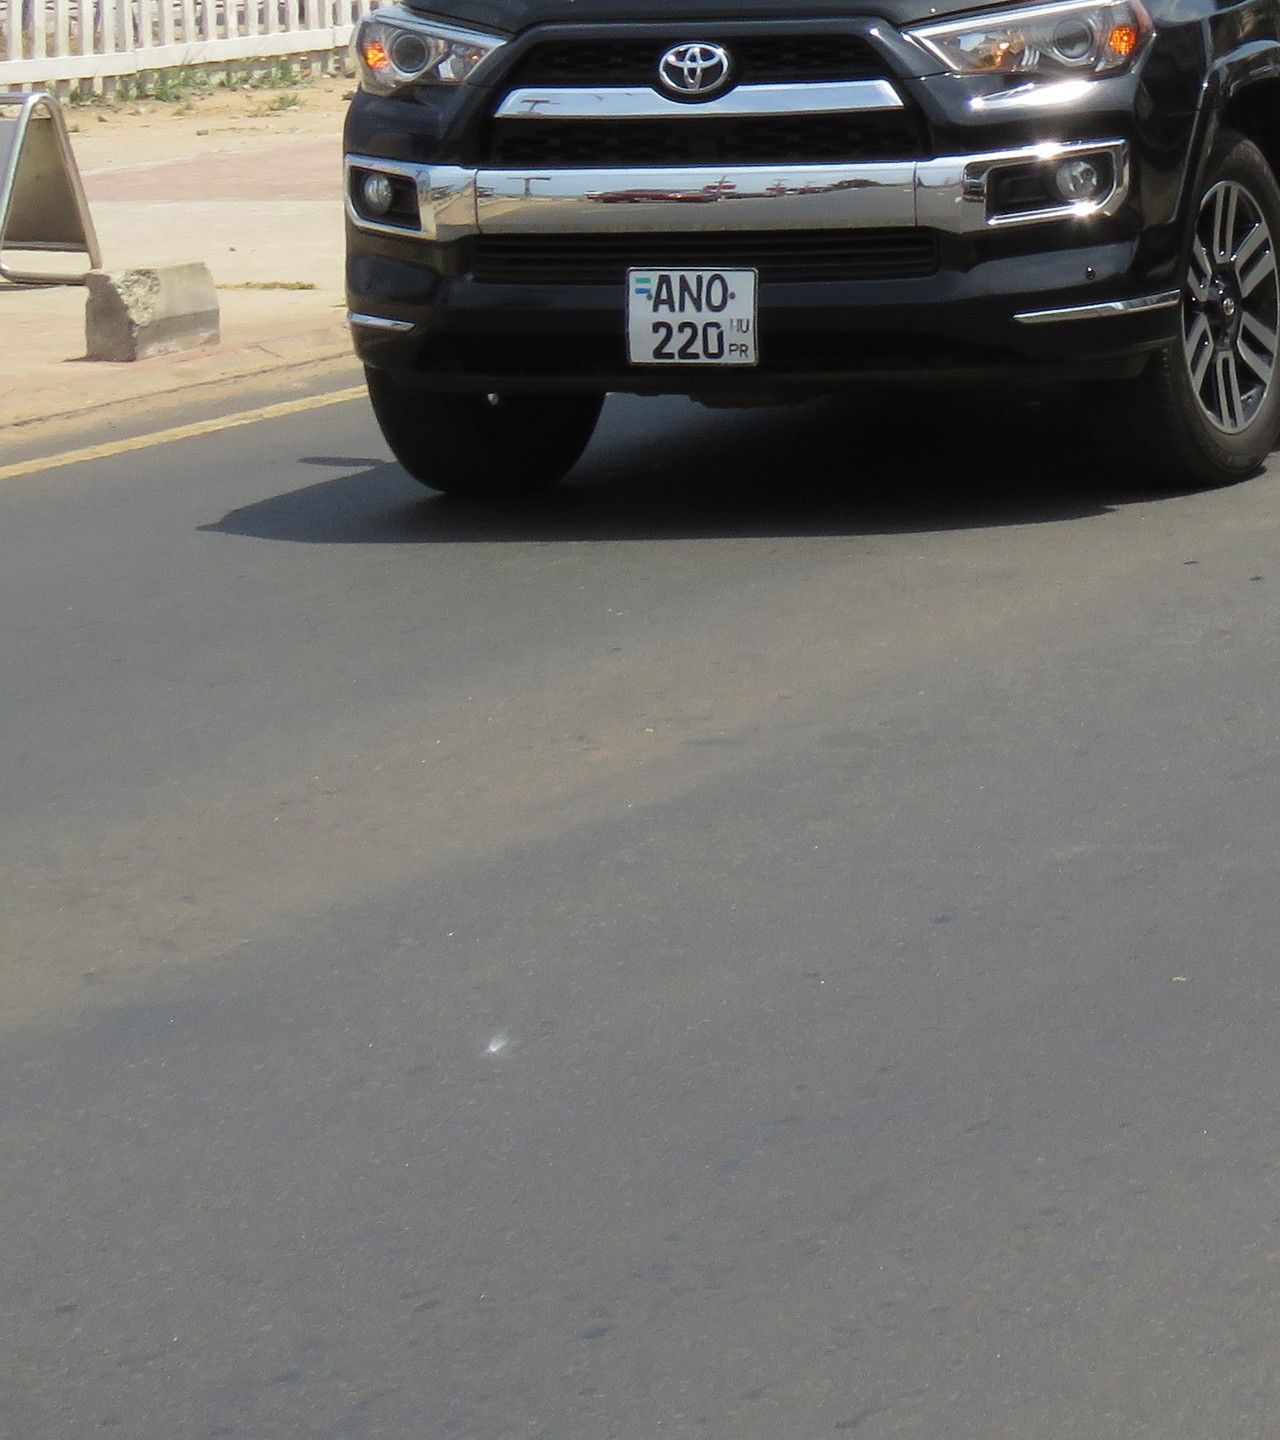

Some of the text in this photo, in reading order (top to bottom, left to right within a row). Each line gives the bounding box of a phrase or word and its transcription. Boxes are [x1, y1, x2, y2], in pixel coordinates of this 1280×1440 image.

[652, 273, 729, 313] ANO
[651, 321, 725, 360] 220
[729, 343, 749, 358] PR
